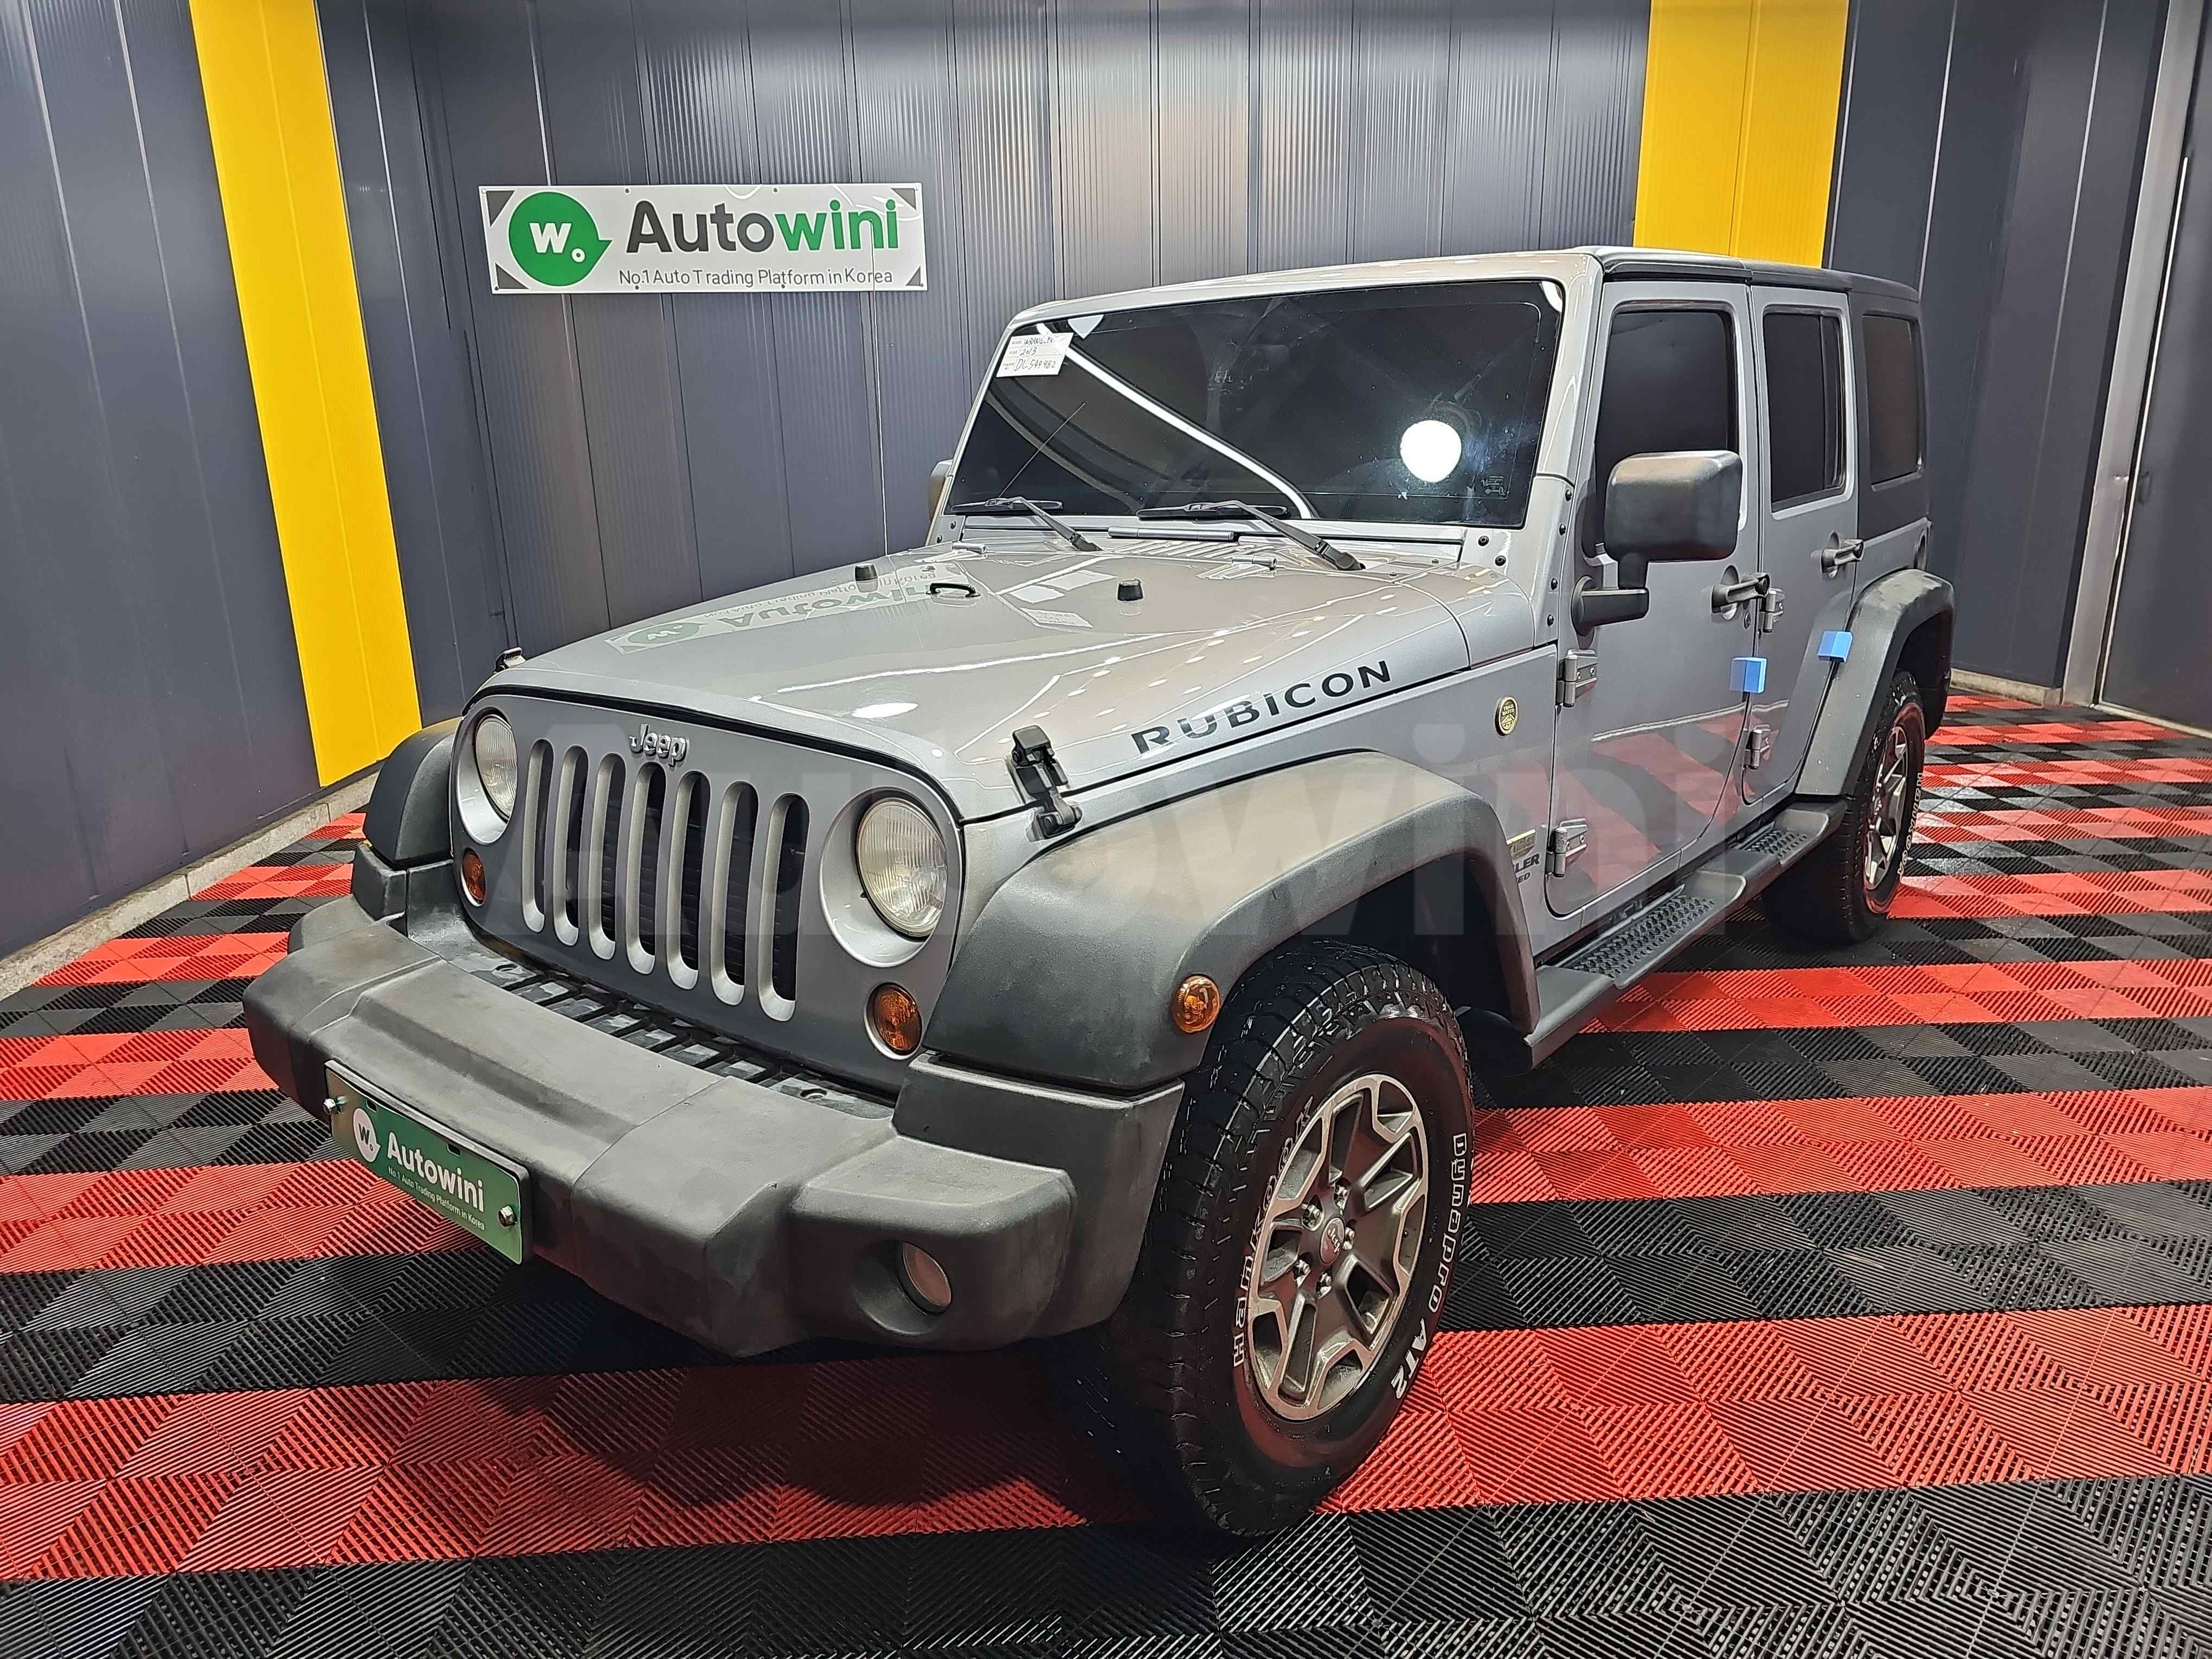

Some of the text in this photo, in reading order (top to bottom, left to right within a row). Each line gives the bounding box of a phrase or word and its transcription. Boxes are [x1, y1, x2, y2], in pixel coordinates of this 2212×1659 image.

[625, 198, 900, 254] Autowini
[653, 269, 690, 284] Auto
[692, 269, 754, 288] Trading
[758, 268, 825, 285] Platform
[827, 268, 843, 284] in
[844, 267, 892, 284] Korea
[1019, 346, 1037, 356] 2013
[1130, 660, 1392, 755] RUBICON
[628, 723, 687, 767] Jeep
[387, 1131, 485, 1212] Autowini
[388, 1165, 485, 1231] No.1 Auto Trading Platform in Korea
[1391, 1317, 1427, 1400] AT2
